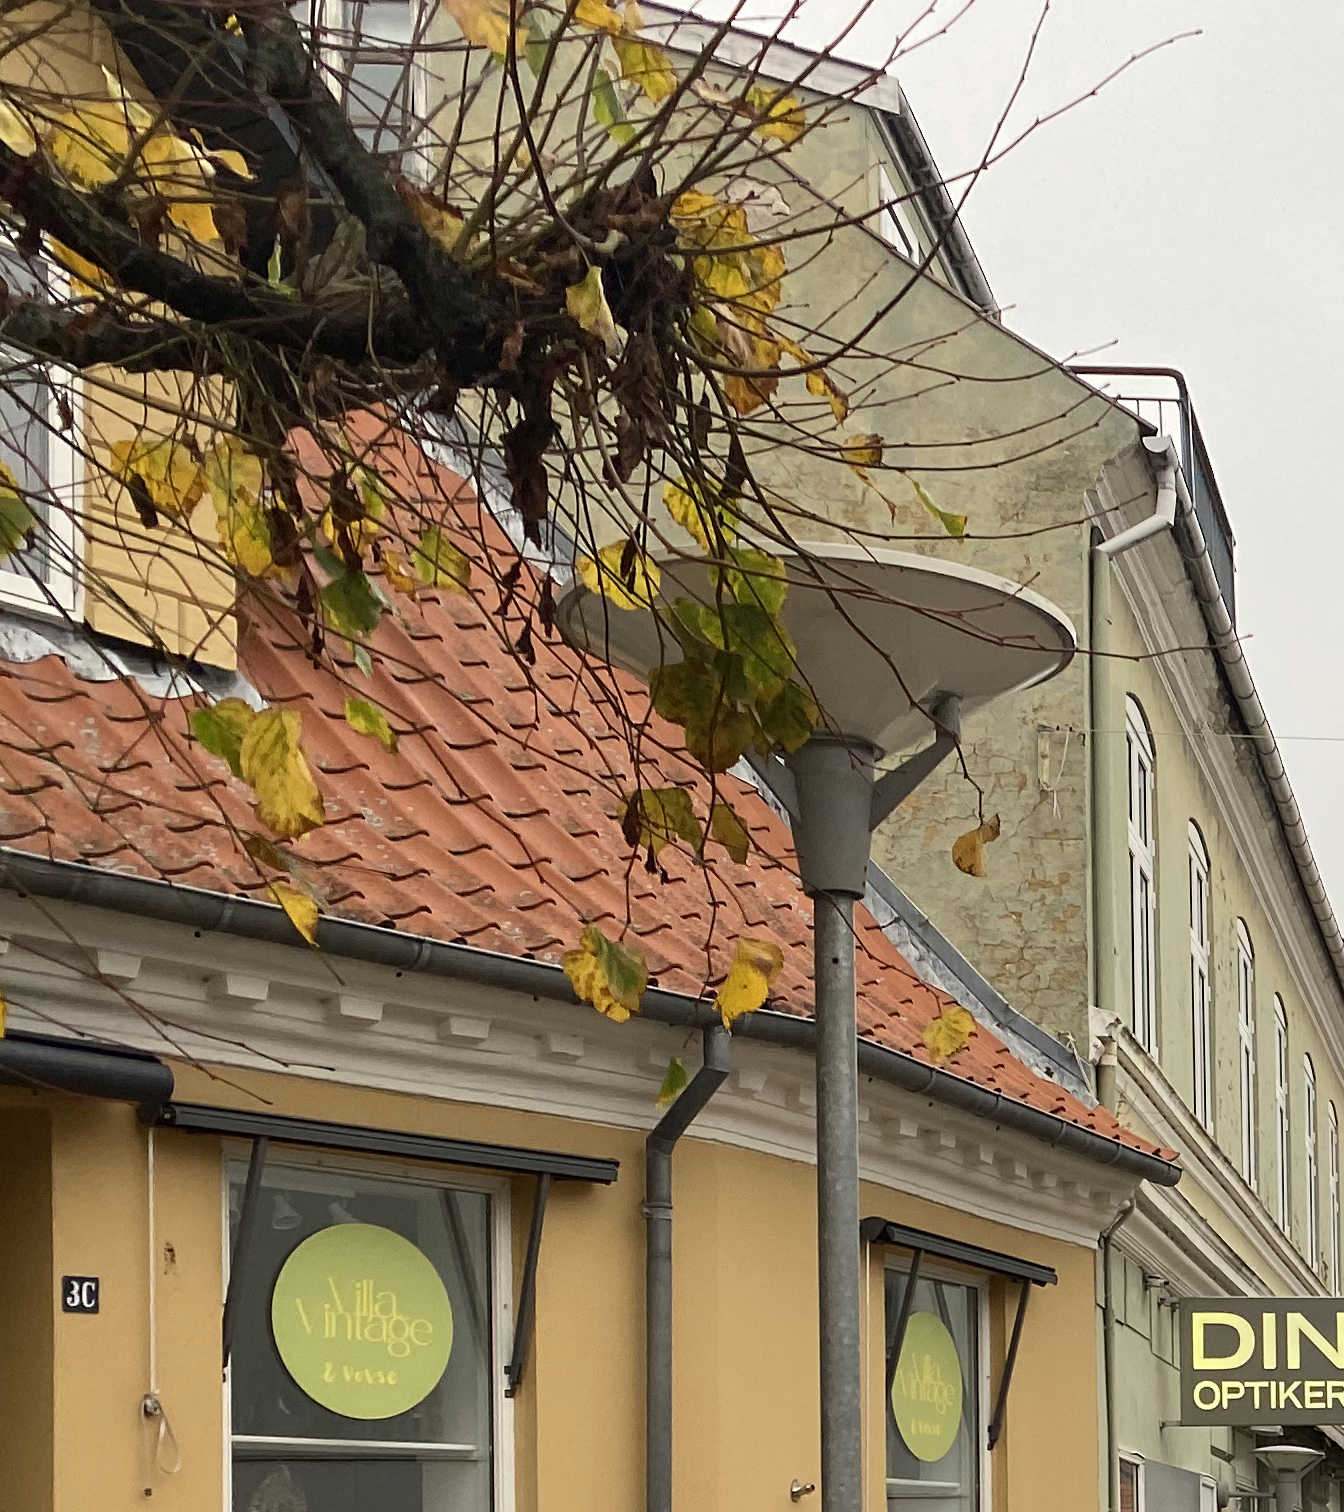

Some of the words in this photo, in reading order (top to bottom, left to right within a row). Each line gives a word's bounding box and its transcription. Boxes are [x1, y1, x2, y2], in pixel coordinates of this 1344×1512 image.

[66, 1280, 96, 1307] 3C
[327, 1276, 397, 1319] Villa
[295, 1297, 434, 1358] Vintage
